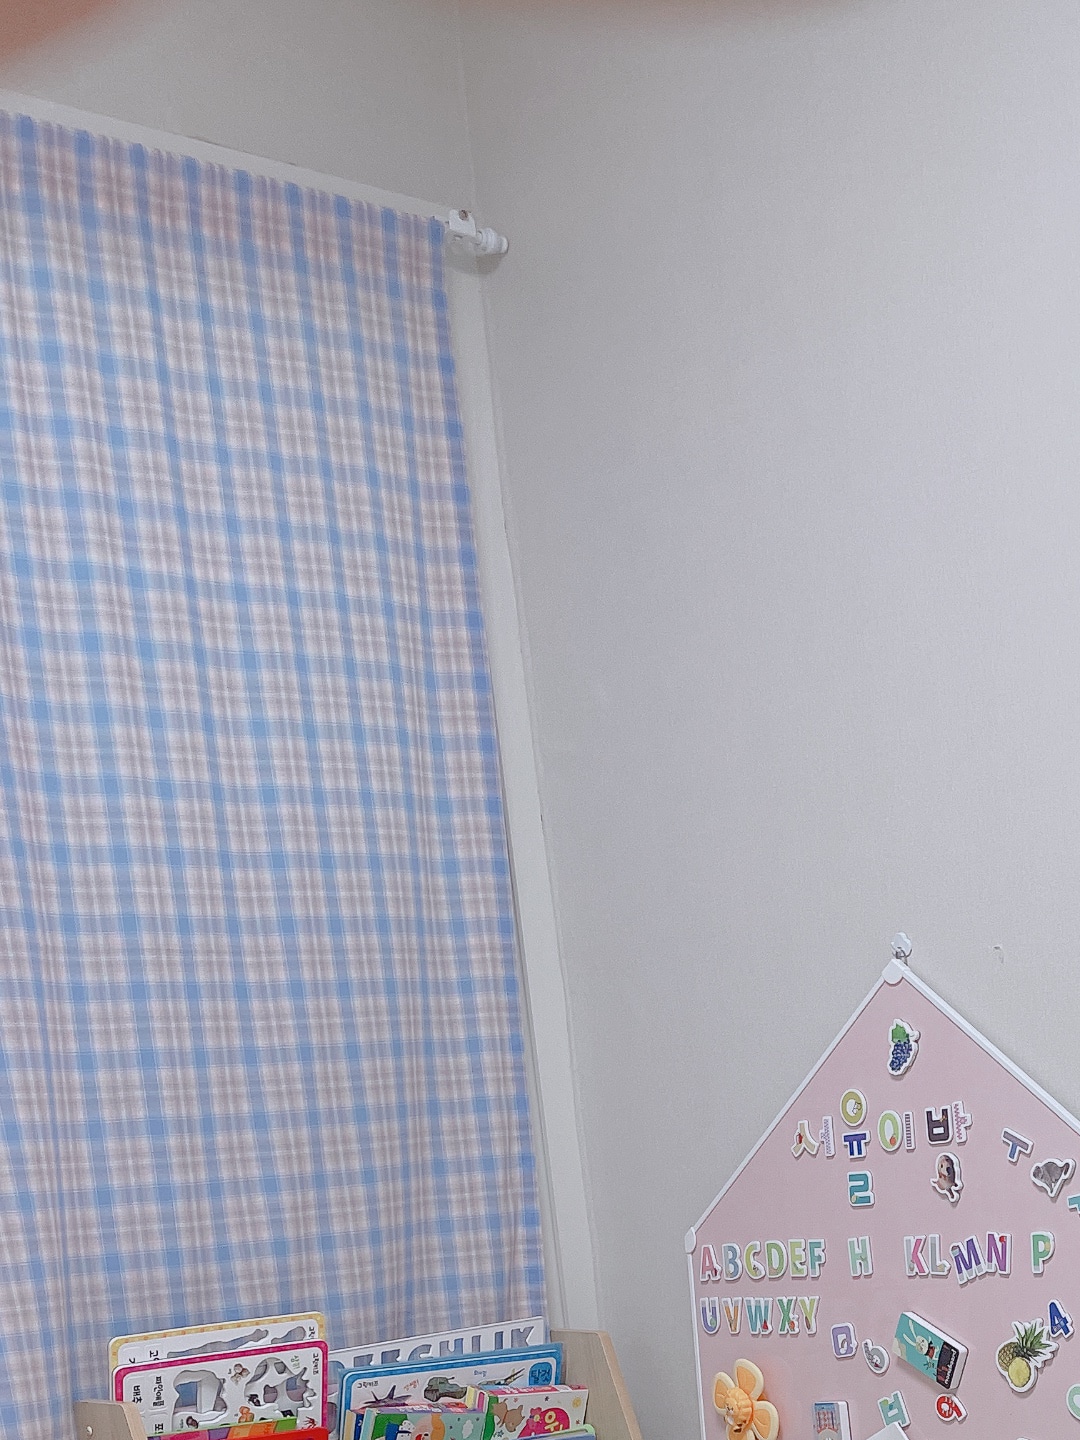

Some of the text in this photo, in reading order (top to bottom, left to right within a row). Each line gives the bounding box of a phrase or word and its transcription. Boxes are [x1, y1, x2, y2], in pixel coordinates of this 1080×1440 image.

[699, 1240, 823, 1281] ABCDEF
[849, 1237, 873, 1277] H
[904, 1232, 1012, 1285] KLMN
[1031, 1233, 1054, 1274] P
[699, 1296, 820, 1335] UVWXY
